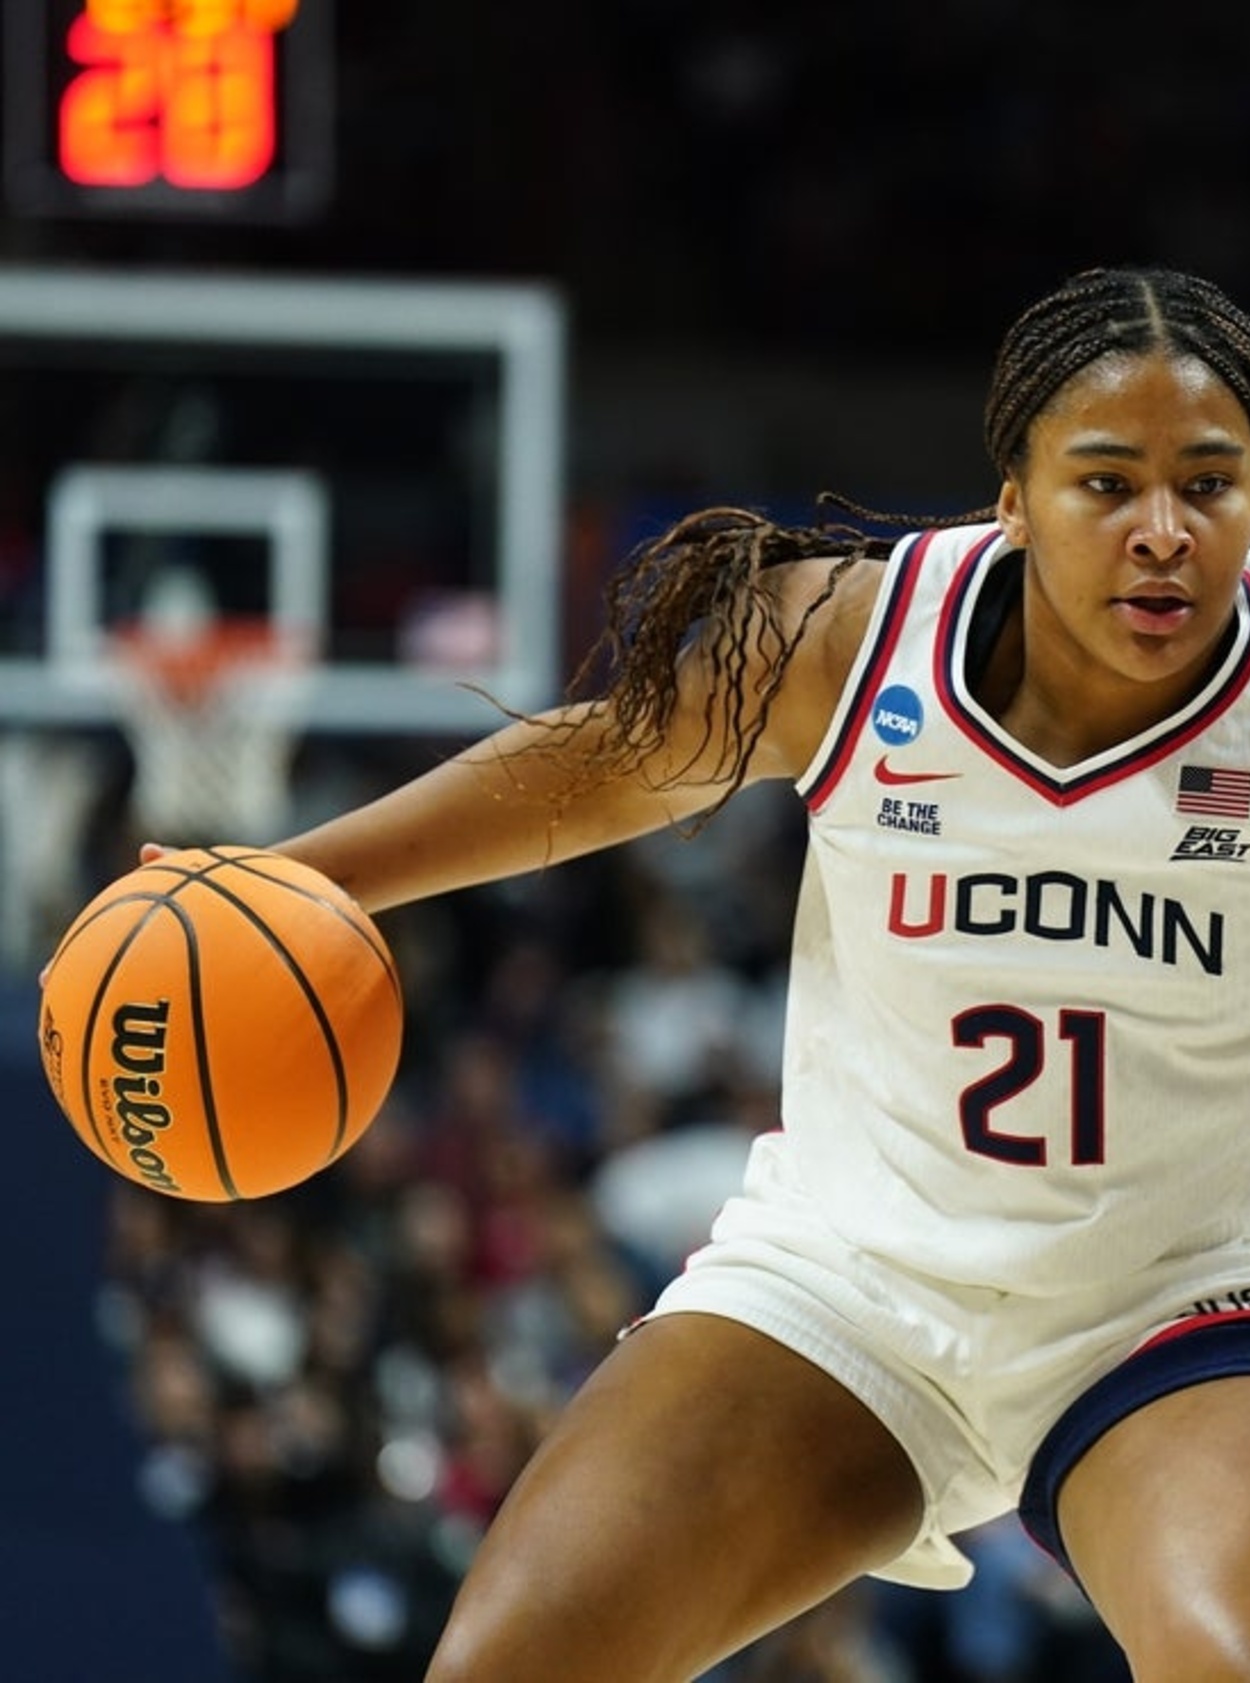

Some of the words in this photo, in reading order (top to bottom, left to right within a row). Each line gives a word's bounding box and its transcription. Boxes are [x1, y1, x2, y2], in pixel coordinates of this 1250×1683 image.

[875, 709, 918, 736] NCAA
[881, 798, 903, 815] BE
[908, 802, 939, 819] THE
[877, 813, 941, 836] CHANGE
[1184, 825, 1241, 842] BIG
[888, 871, 1224, 976] UCONN
[110, 997, 181, 1192] Wilson
[950, 1002, 1106, 1168] 21
